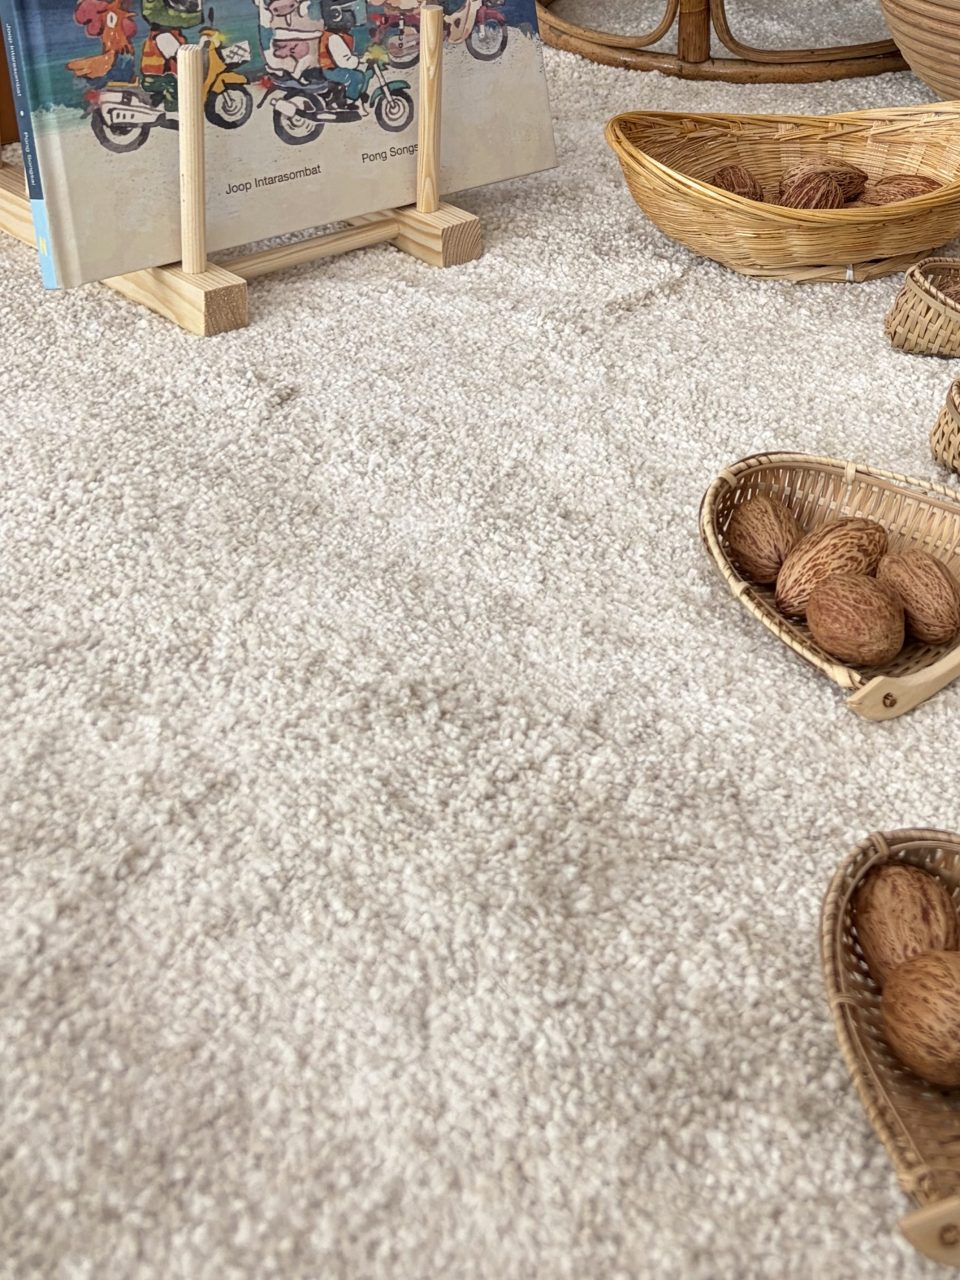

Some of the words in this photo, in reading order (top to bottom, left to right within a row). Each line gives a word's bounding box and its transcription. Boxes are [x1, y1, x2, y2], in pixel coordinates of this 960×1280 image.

[361, 149, 388, 163] Pong
[389, 143, 418, 157] Songs
[225, 178, 253, 195] Joop
[254, 164, 322, 188] Intarasombat
